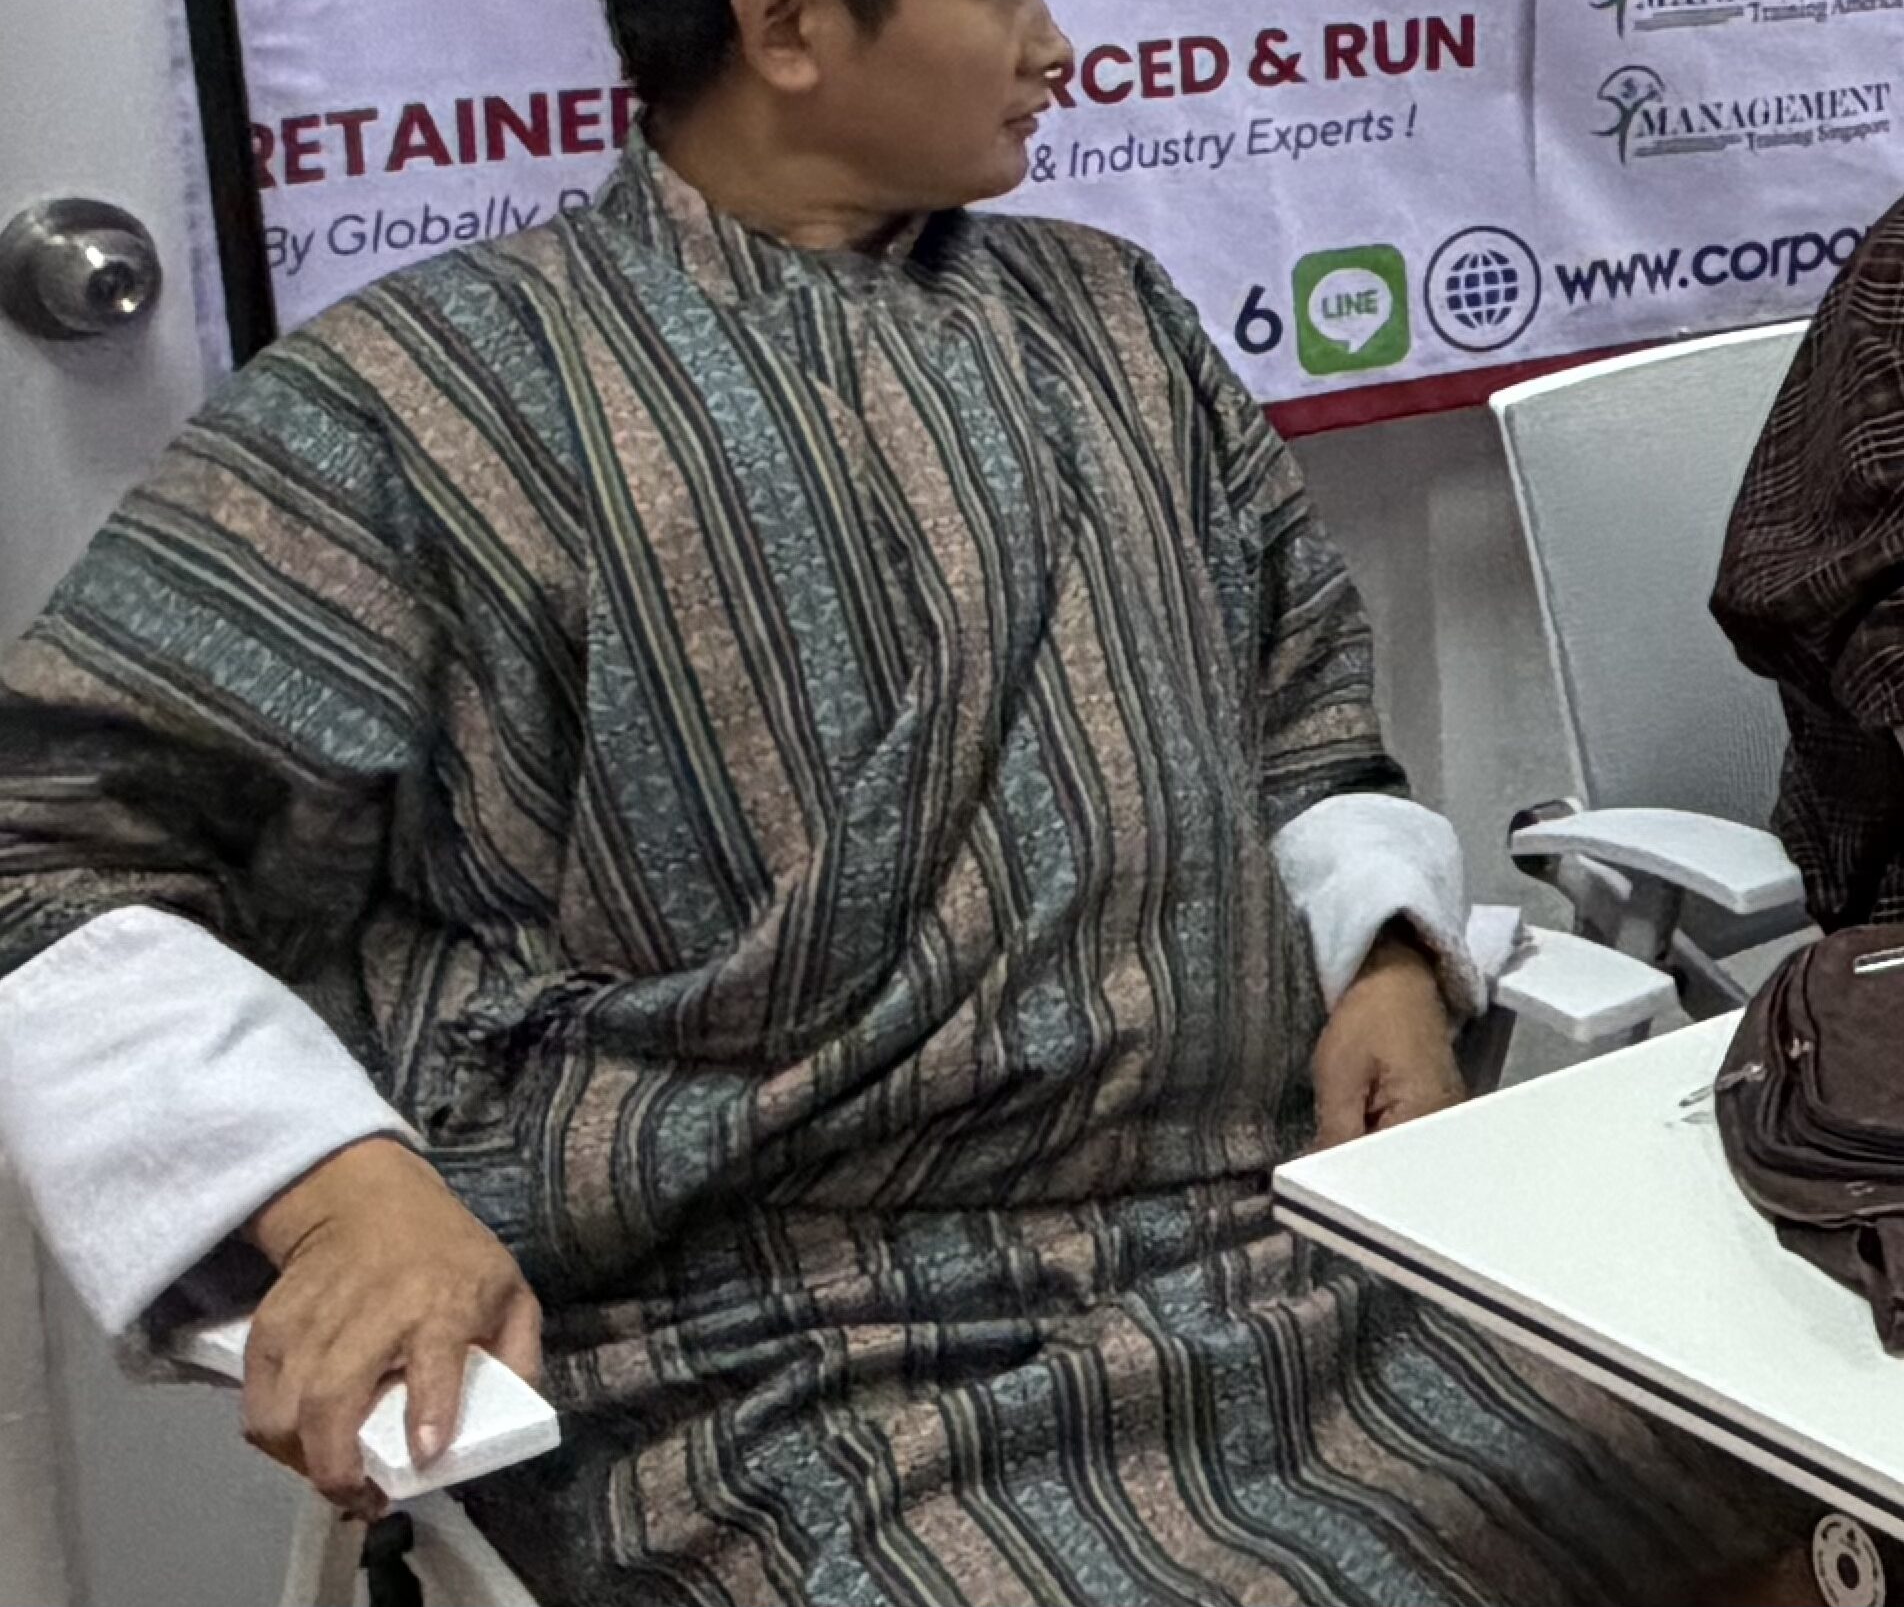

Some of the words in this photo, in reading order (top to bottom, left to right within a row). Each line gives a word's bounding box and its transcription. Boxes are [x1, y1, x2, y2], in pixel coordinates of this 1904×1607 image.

[1048, 36, 1230, 109] RCED
[1247, 27, 1307, 86] &
[1323, 14, 1475, 81] RUN
[1070, 130, 1235, 179] Industry
[1248, 110, 1395, 160] Experts
[1637, 82, 1892, 139] MANAGEMENT
[262, 226, 315, 276] By
[328, 195, 541, 255] Globally
[1322, 289, 1379, 320] LINE
